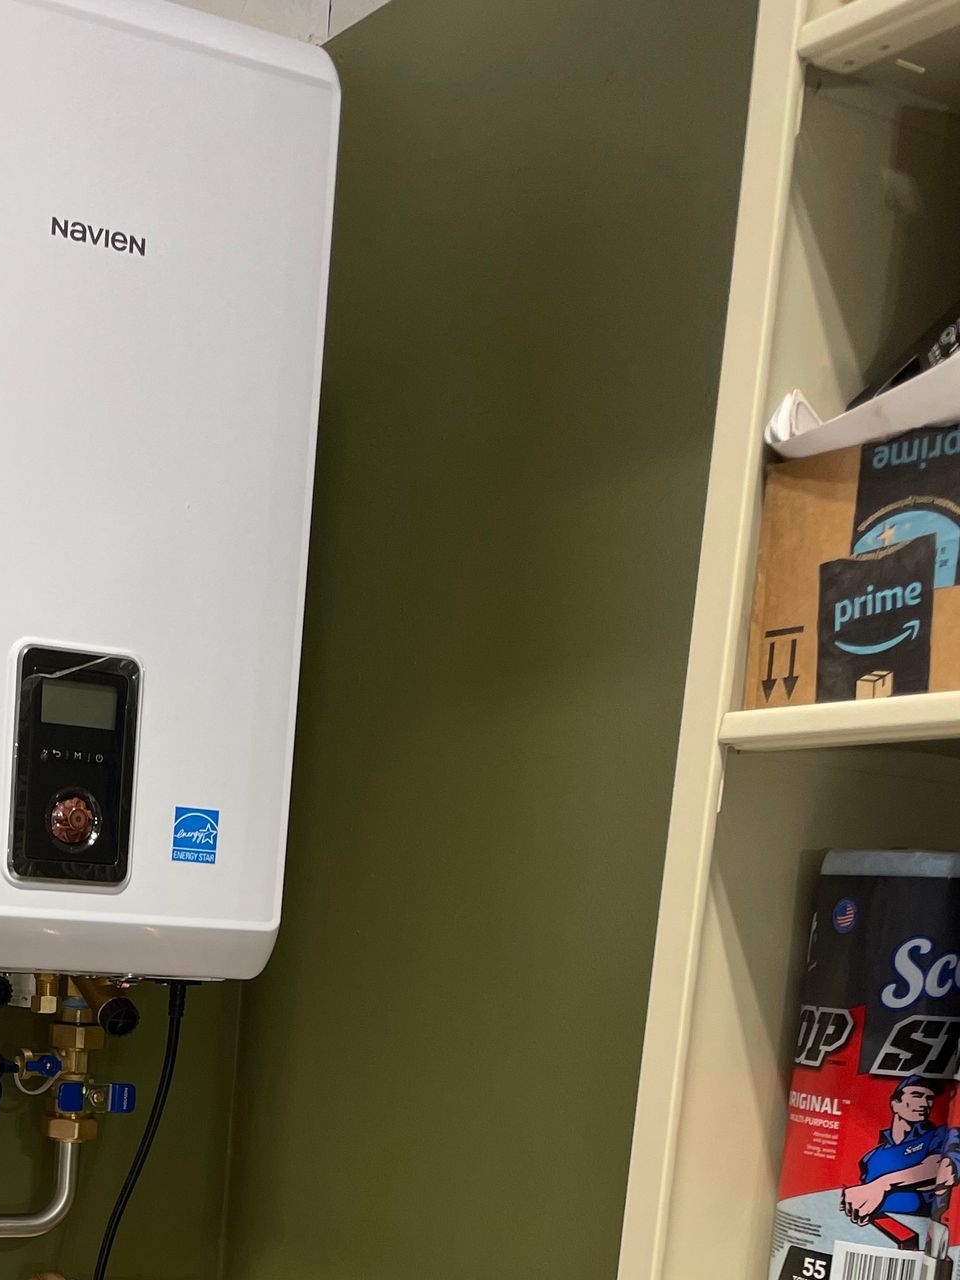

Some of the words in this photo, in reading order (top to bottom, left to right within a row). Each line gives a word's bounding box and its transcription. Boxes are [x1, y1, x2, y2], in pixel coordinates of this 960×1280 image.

[834, 582, 922, 632] prime
[173, 850, 198, 861] ENERGY
[198, 853, 215, 863] STAR
[881, 937, 960, 1009] Sc
[904, 1143, 925, 1156] Scott
[802, 1256, 827, 1280] 55
